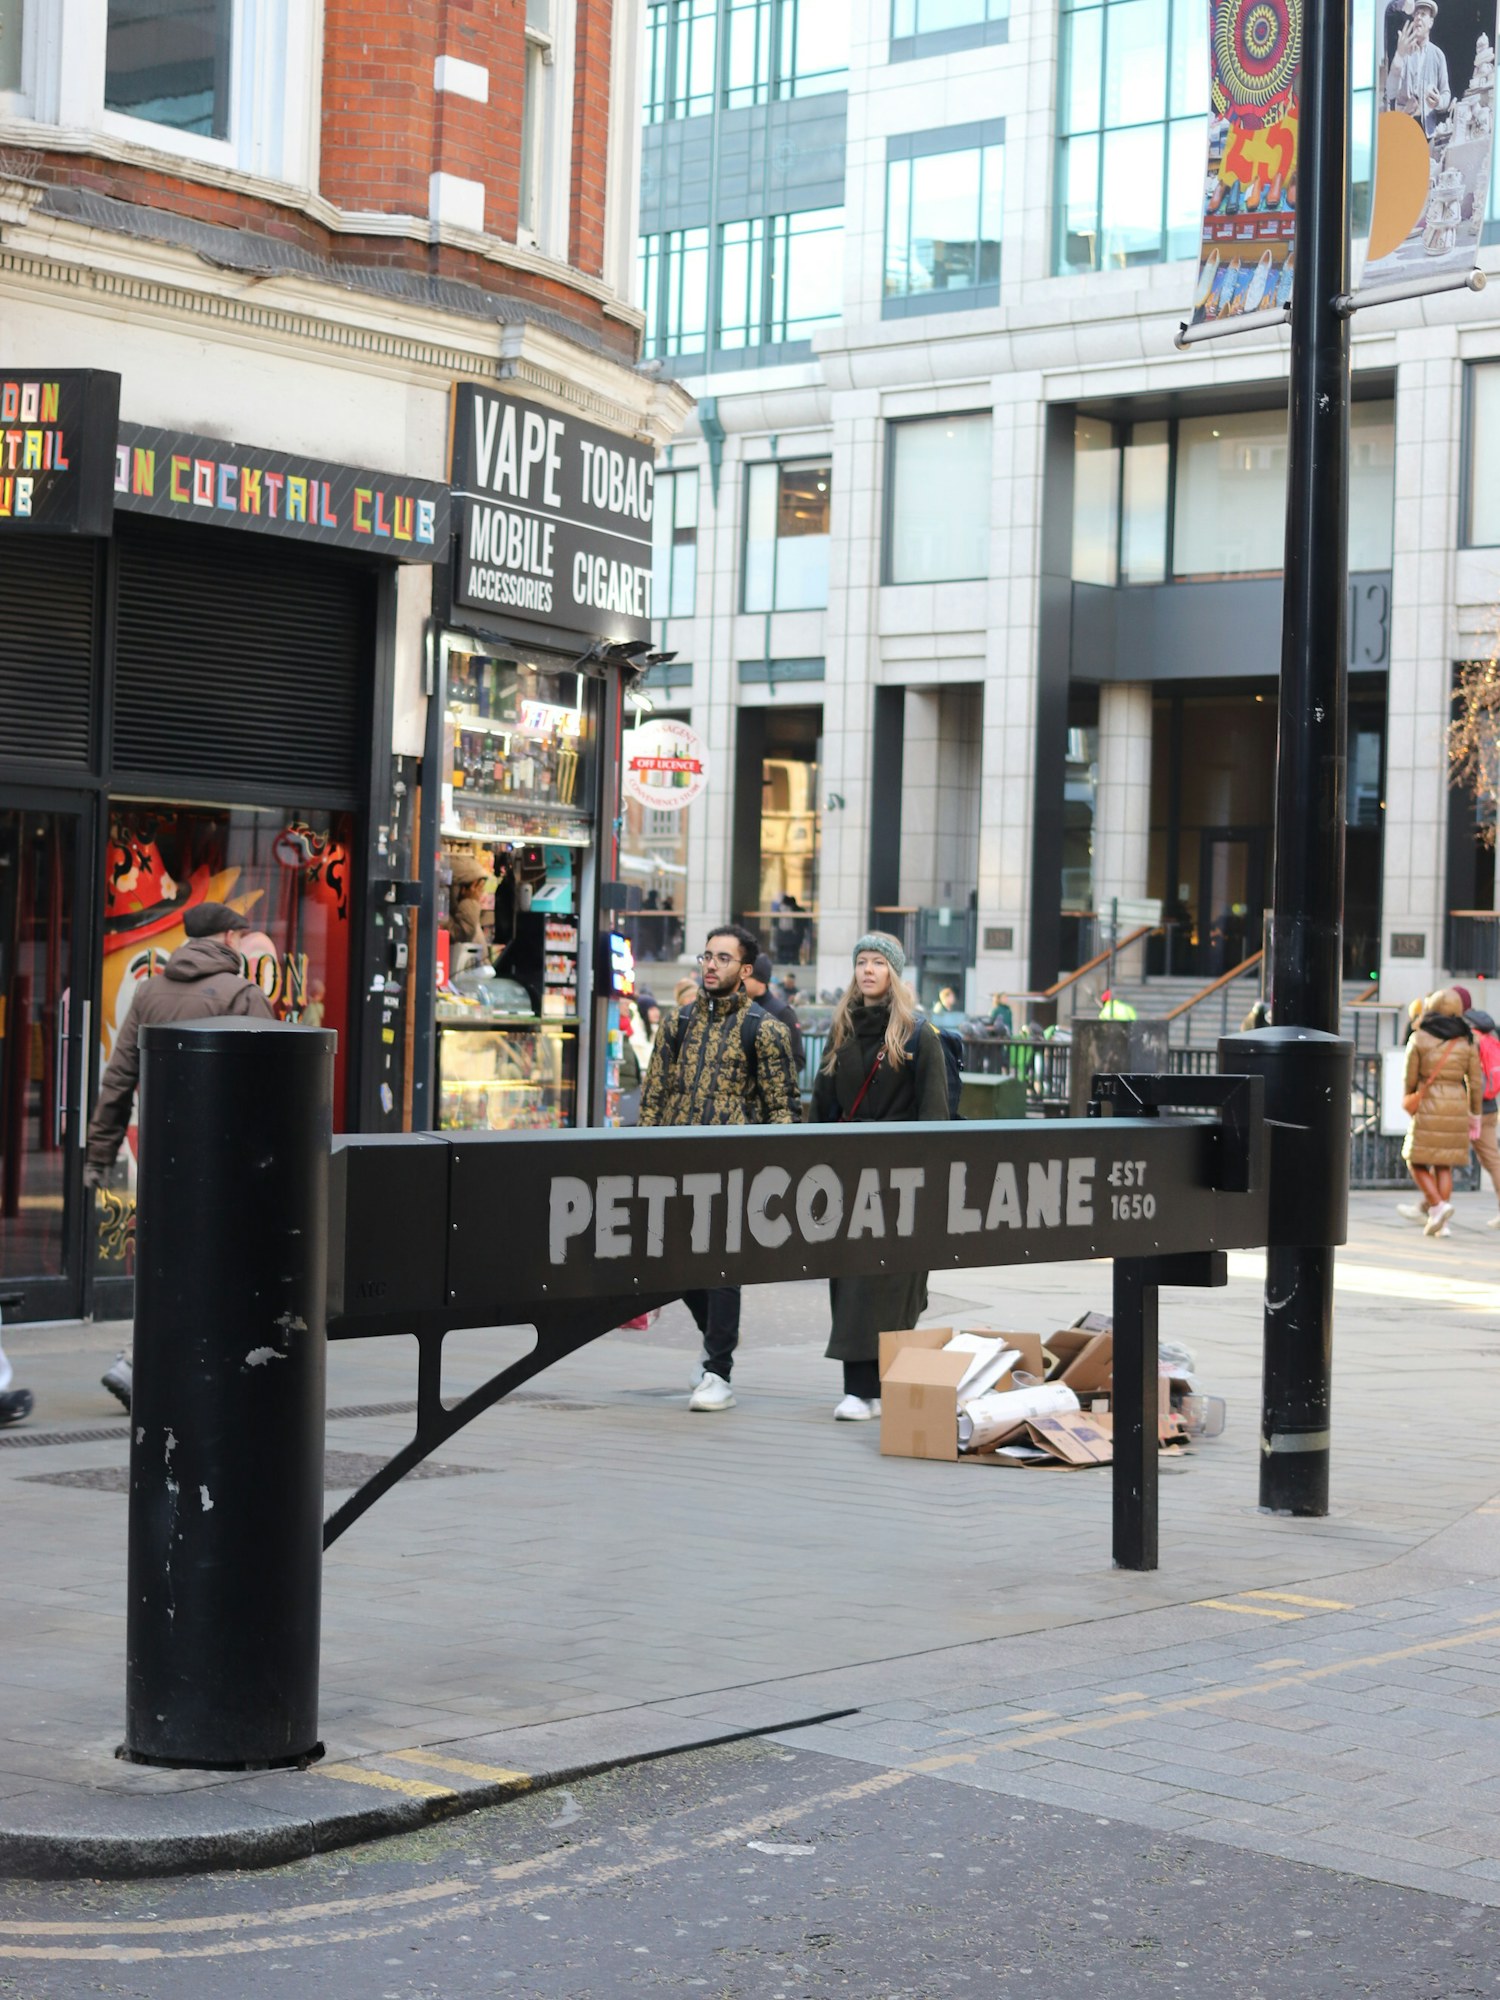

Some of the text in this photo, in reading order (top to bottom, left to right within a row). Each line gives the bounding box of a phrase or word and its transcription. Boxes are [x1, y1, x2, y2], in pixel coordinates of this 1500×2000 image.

[0, 430, 69, 470] TAIL
[474, 395, 653, 522] VAPE TOBAC
[170, 454, 338, 528] COCKTAIL
[353, 487, 435, 544] CLUB
[469, 504, 652, 619] MOBILE CIGARET
[468, 566, 553, 613] ACCESSORIES
[636, 759, 695, 770] OFF LICENCE
[1110, 1161, 1148, 1188] EST
[547, 1157, 1097, 1265] PETTICOAT LANE
[1111, 1193, 1156, 1221] 1650
